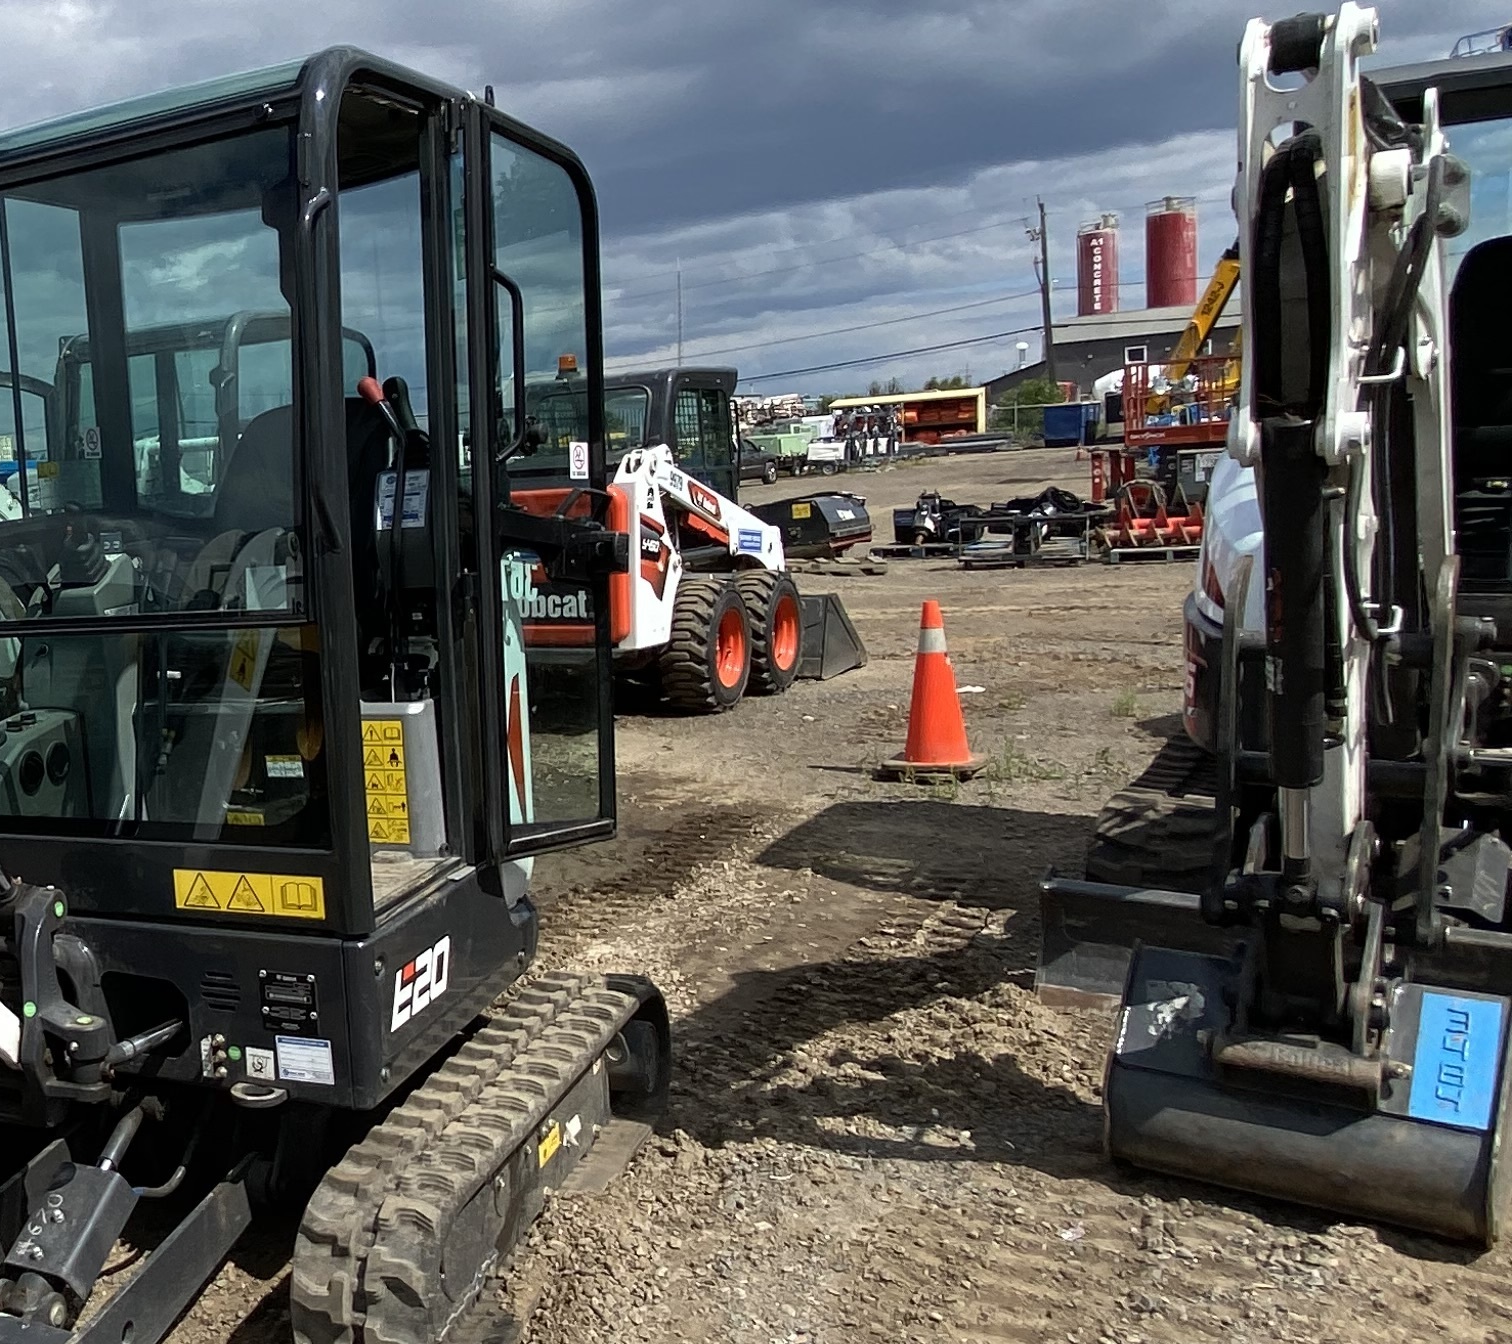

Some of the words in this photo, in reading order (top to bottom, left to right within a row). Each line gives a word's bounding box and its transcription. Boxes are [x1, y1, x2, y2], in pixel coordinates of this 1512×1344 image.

[1093, 247, 1102, 310] CONCRETE
[517, 590, 587, 618] obcat
[391, 936, 450, 1033] E20
